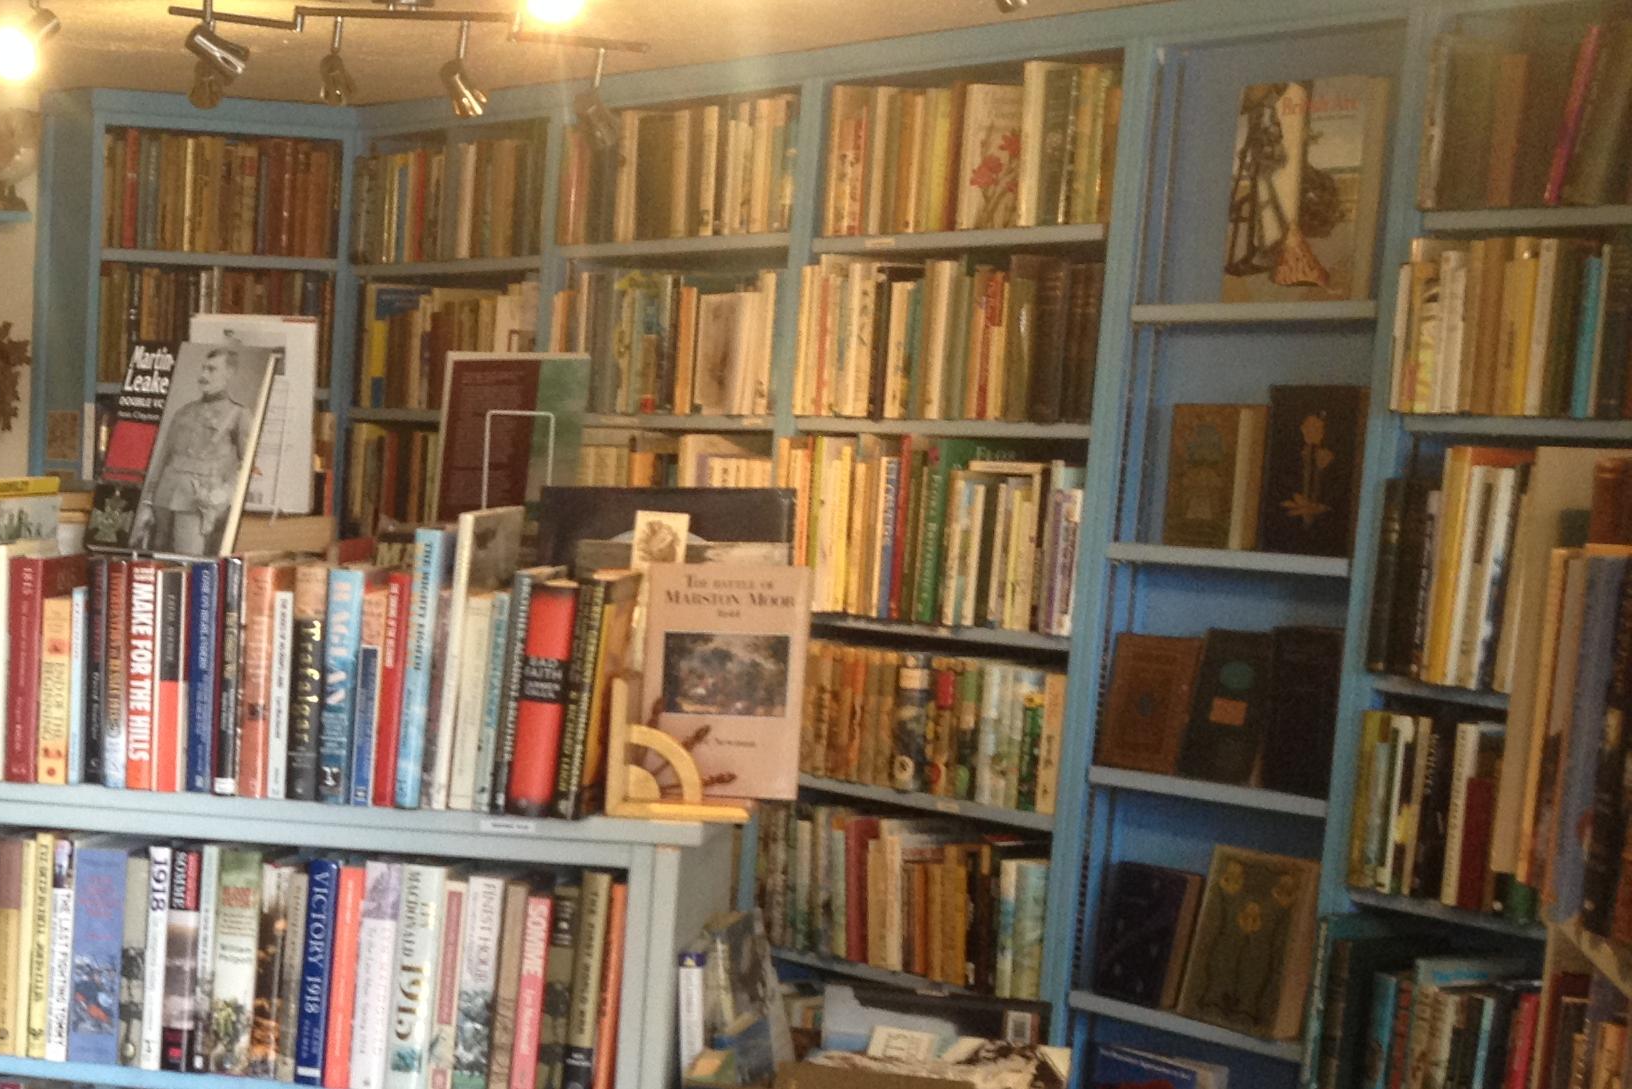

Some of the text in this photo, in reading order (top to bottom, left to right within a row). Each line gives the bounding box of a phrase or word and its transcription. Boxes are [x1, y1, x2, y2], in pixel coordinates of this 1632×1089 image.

[123, 369, 170, 394] Leake
[129, 345, 175, 371] Martin
[21, 567, 33, 595] 1815
[666, 590, 795, 607] MARSTON MOOR
[131, 583, 154, 636] MAKE
[413, 542, 433, 671] THE MIGHTY EIGHTH
[130, 639, 152, 675] FOR
[297, 619, 322, 742] Trafalgar
[503, 578, 530, 761] BROTHER AGAINST BROTHER
[523, 666, 563, 681] FAITH
[529, 657, 558, 667] BAD
[129, 679, 151, 711] THE
[128, 715, 150, 761] HILLS
[60, 893, 72, 913] THE
[150, 857, 168, 912] 1918
[171, 851, 188, 908] SOMME
[401, 871, 422, 958] MACDONALD
[480, 883, 497, 932] FINEST
[58, 917, 71, 948] LAST
[303, 871, 329, 1014] VICTORY 1918
[521, 904, 548, 979] SOMME
[55, 952, 69, 1003] FIGHTING
[476, 936, 493, 984] HOUR
[577, 891, 599, 1036] THE FIRST WORLD WAR
[395, 960, 431, 1042] 1915
[54, 1007, 65, 1048] TOMMY
